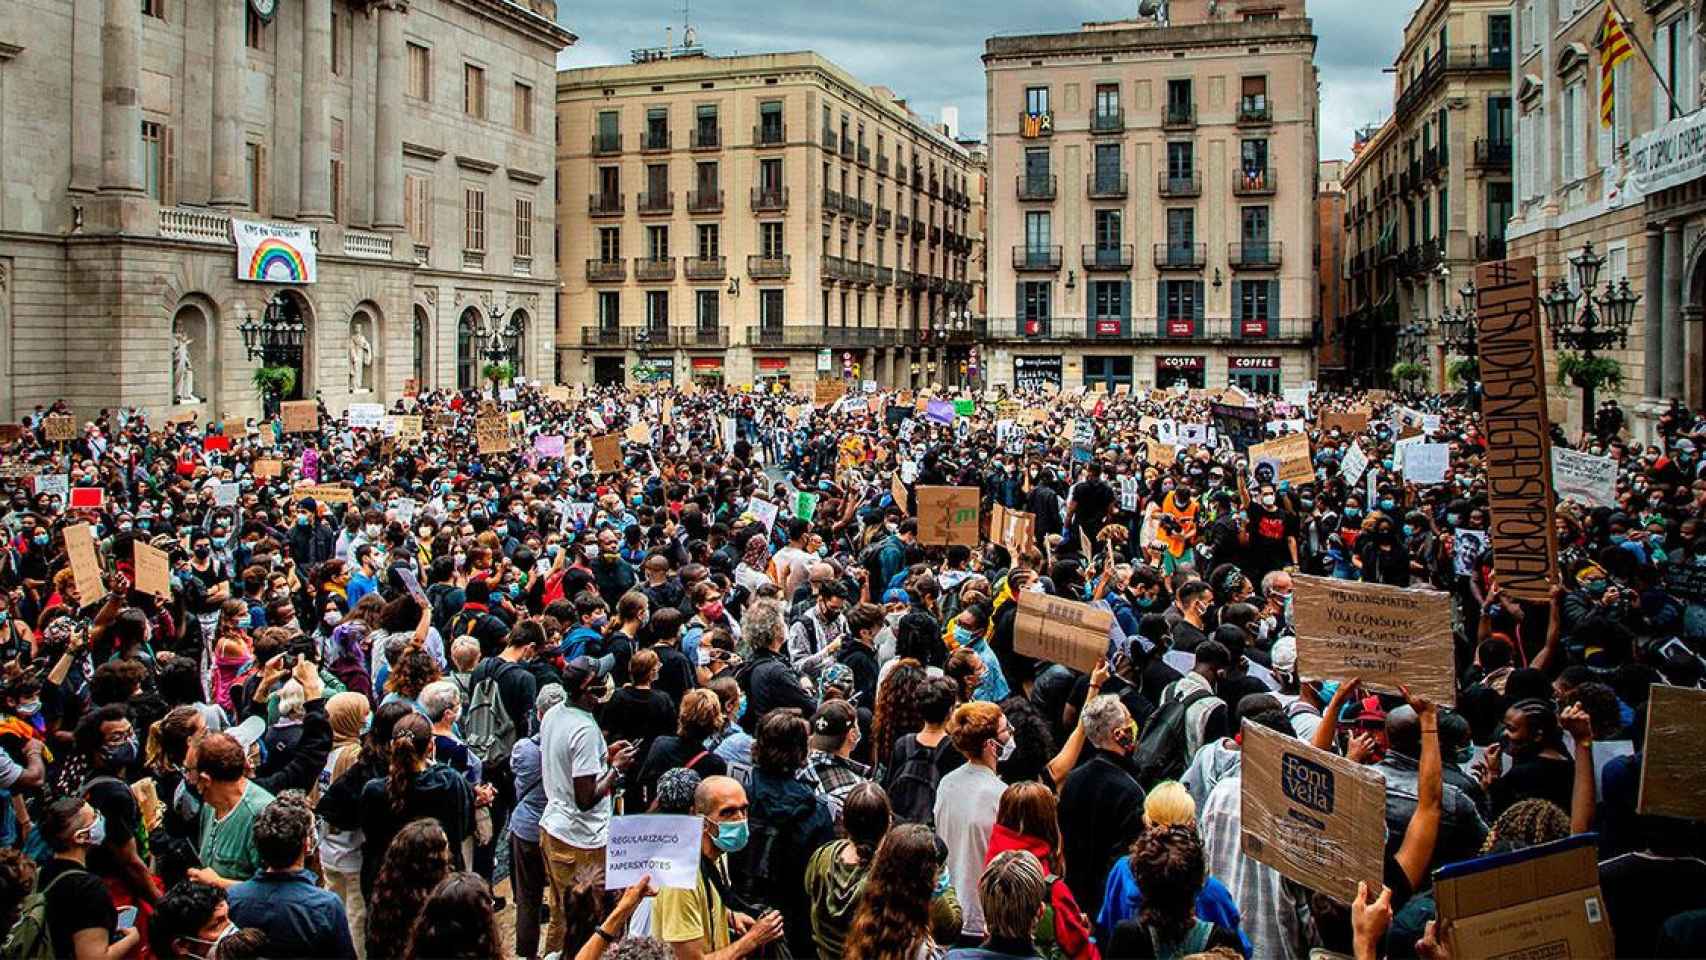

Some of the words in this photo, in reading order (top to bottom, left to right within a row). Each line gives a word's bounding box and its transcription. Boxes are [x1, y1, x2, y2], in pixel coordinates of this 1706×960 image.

[1164, 358, 1197, 367] COSTA
[1236, 358, 1273, 367] COFFEE
[1287, 757, 1328, 789] Font
[1287, 777, 1328, 809] Vella
